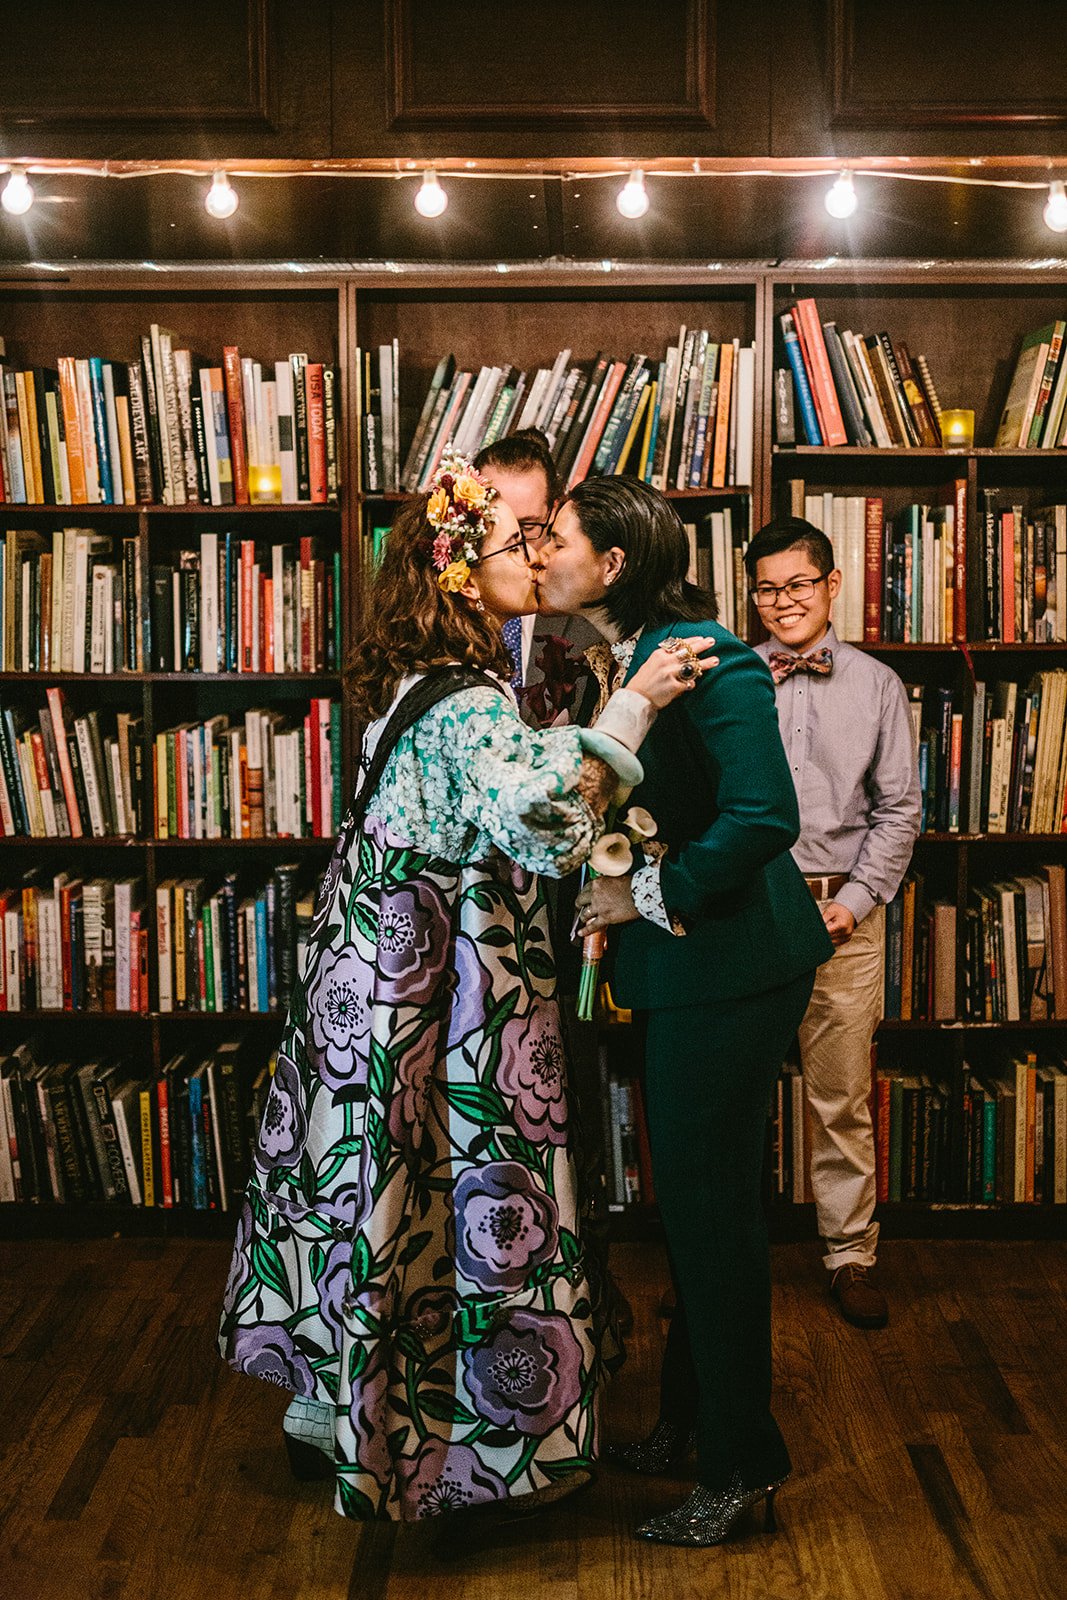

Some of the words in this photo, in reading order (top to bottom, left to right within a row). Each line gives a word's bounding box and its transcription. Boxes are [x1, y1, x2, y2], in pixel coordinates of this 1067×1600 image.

[705, 351, 715, 381] TRICIA
[310, 374, 321, 399] USA
[702, 384, 712, 412] GUILD
[778, 368, 788, 424] PAINTING
[130, 379, 143, 438] MEDIEVAL
[311, 402, 323, 441] TODAY
[135, 439, 146, 462] ART
[170, 445, 181, 485] GUINEA
[189, 573, 197, 615] THROUGH
[64, 589, 73, 654] CIVILIZATION
[81, 745, 91, 778] BOTTLE
[143, 1111, 151, 1182] CONSTELLATIONS
[107, 1147, 127, 1193] COVERS
